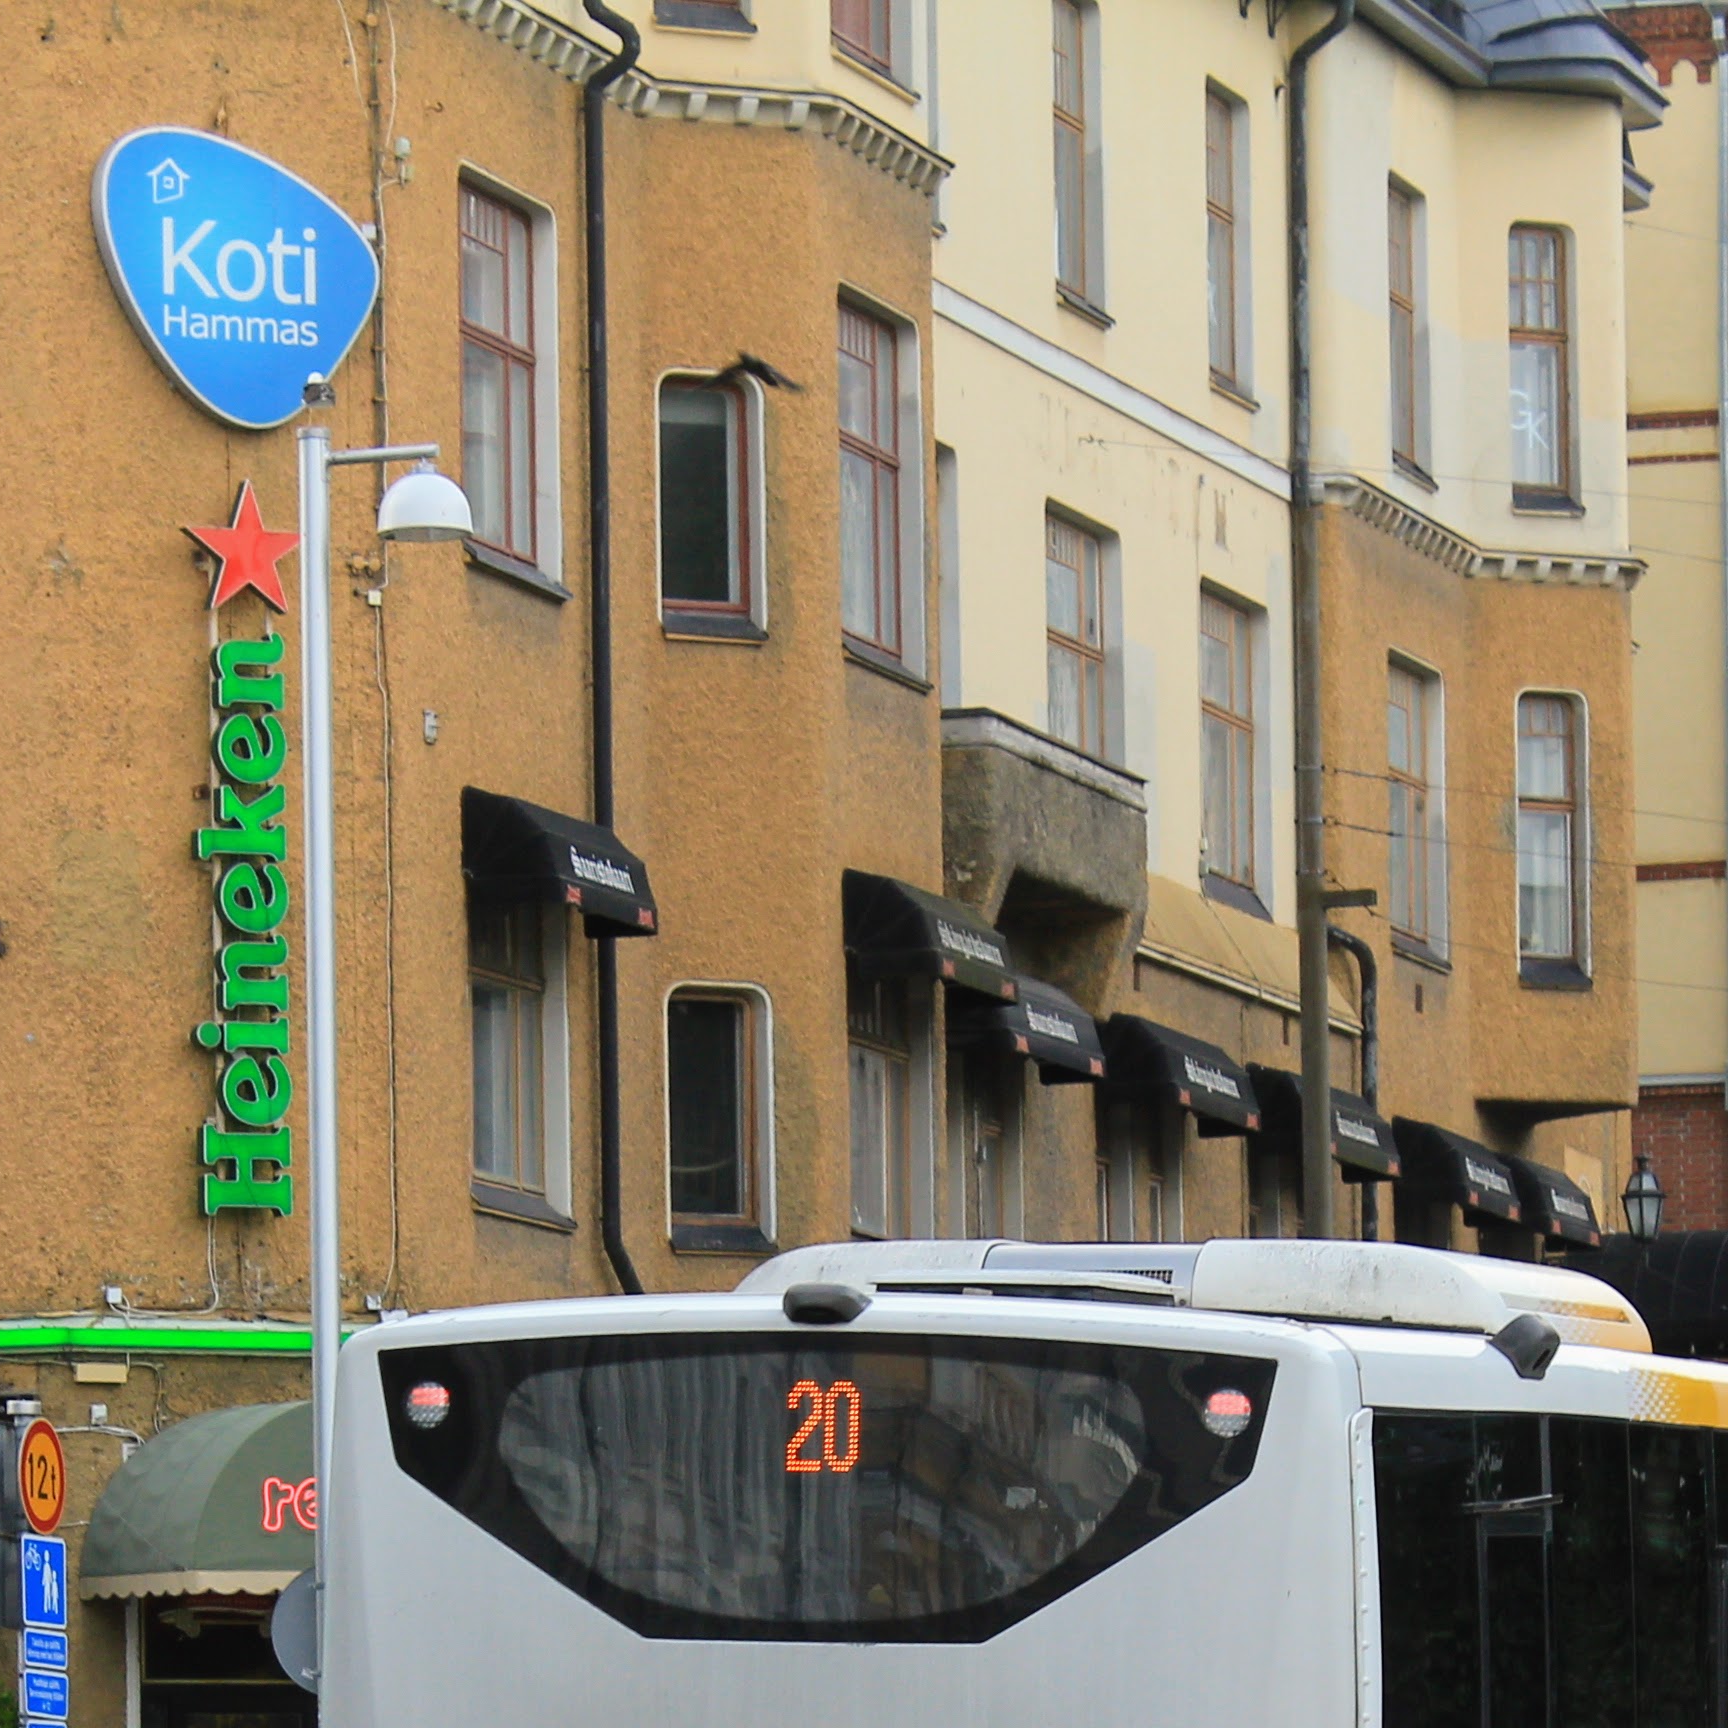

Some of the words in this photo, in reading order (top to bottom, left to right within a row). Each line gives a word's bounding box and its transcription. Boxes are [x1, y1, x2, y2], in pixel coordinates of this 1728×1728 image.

[162, 216, 318, 306] Koti
[163, 303, 319, 348] Hammas
[197, 633, 293, 1216] Heineken
[785, 1378, 861, 1473] 20
